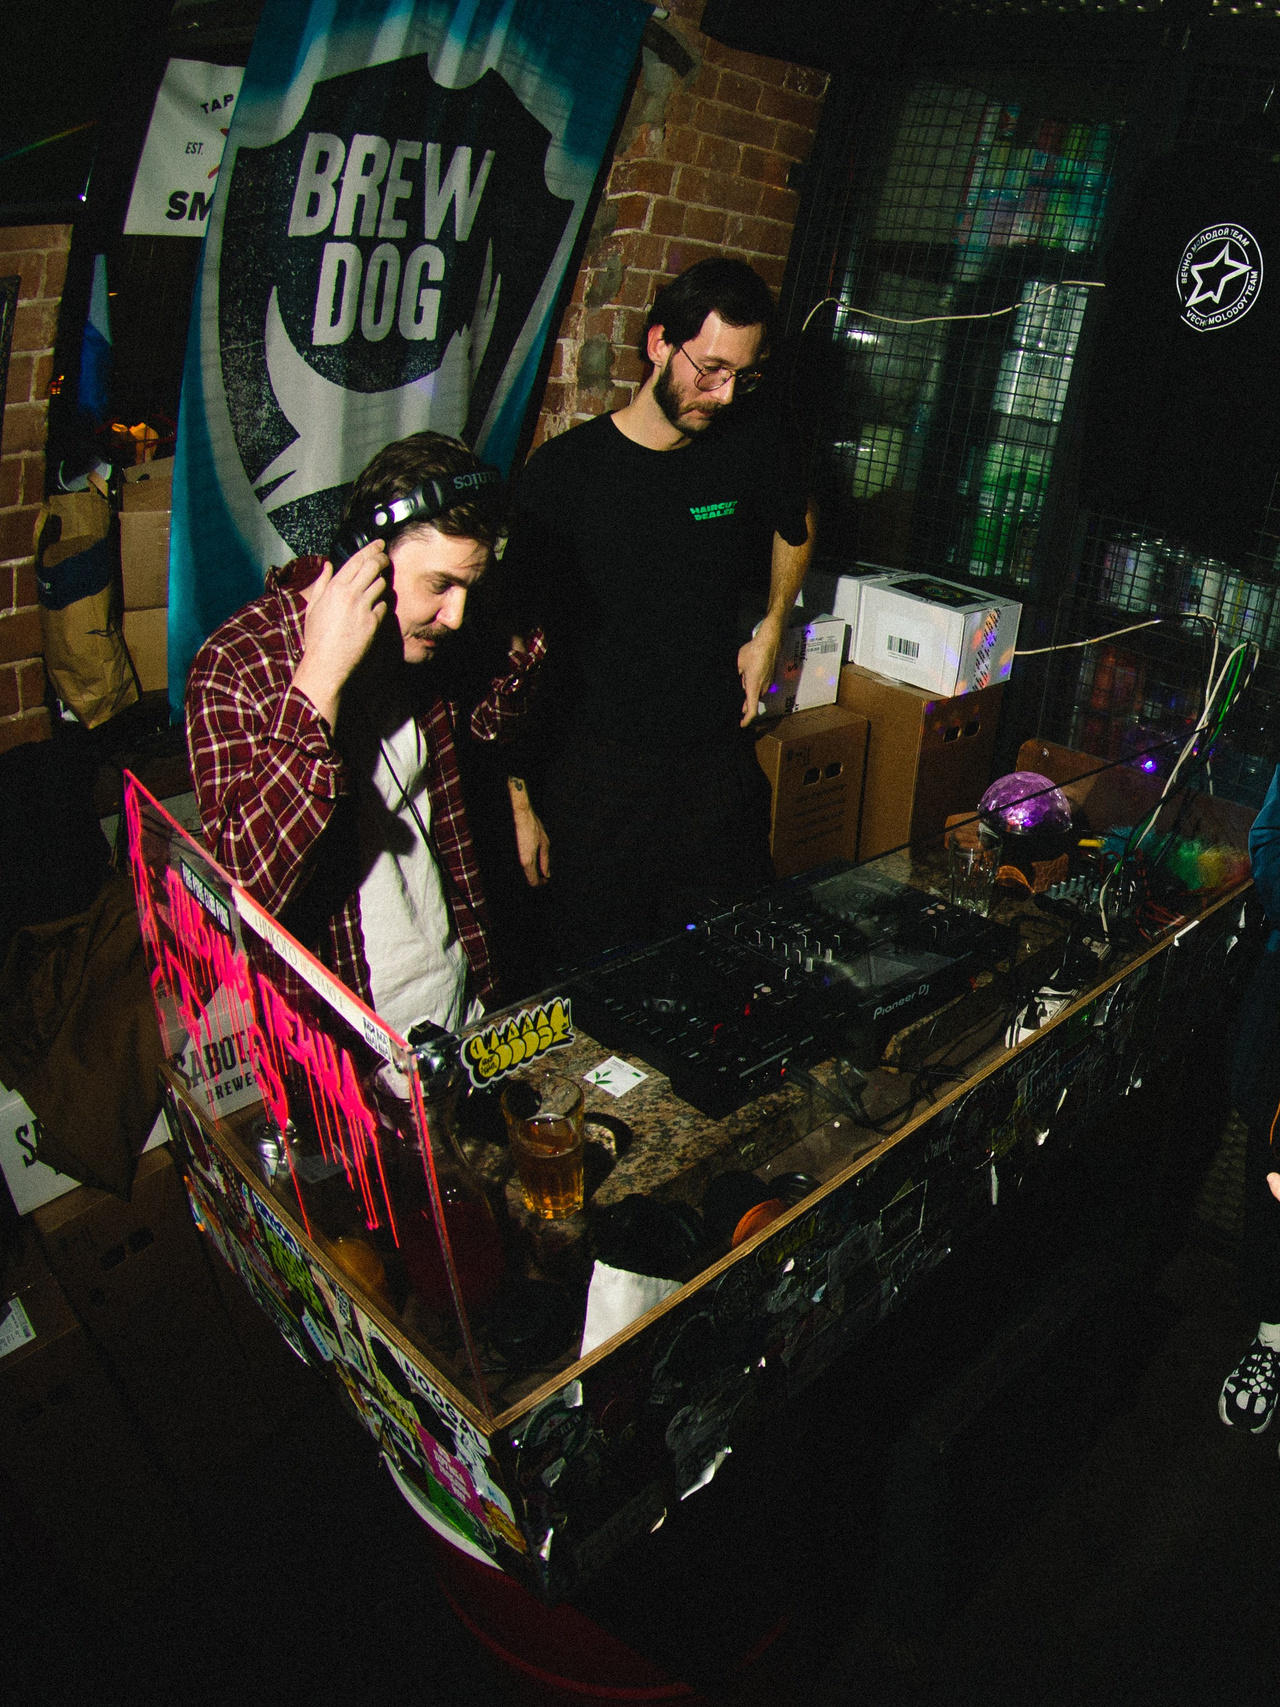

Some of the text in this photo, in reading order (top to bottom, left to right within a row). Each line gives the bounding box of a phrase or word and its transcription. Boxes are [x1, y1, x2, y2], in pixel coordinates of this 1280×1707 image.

[200, 94, 234, 114] TAP
[184, 141, 204, 155] EST.
[287, 132, 496, 242] BREW
[312, 242, 447, 347] DOG
[1208, 296, 1249, 325] MOLODOY
[1245, 270, 1258, 296] TEAM
[873, 984, 930, 1020] Pioneer DJ
